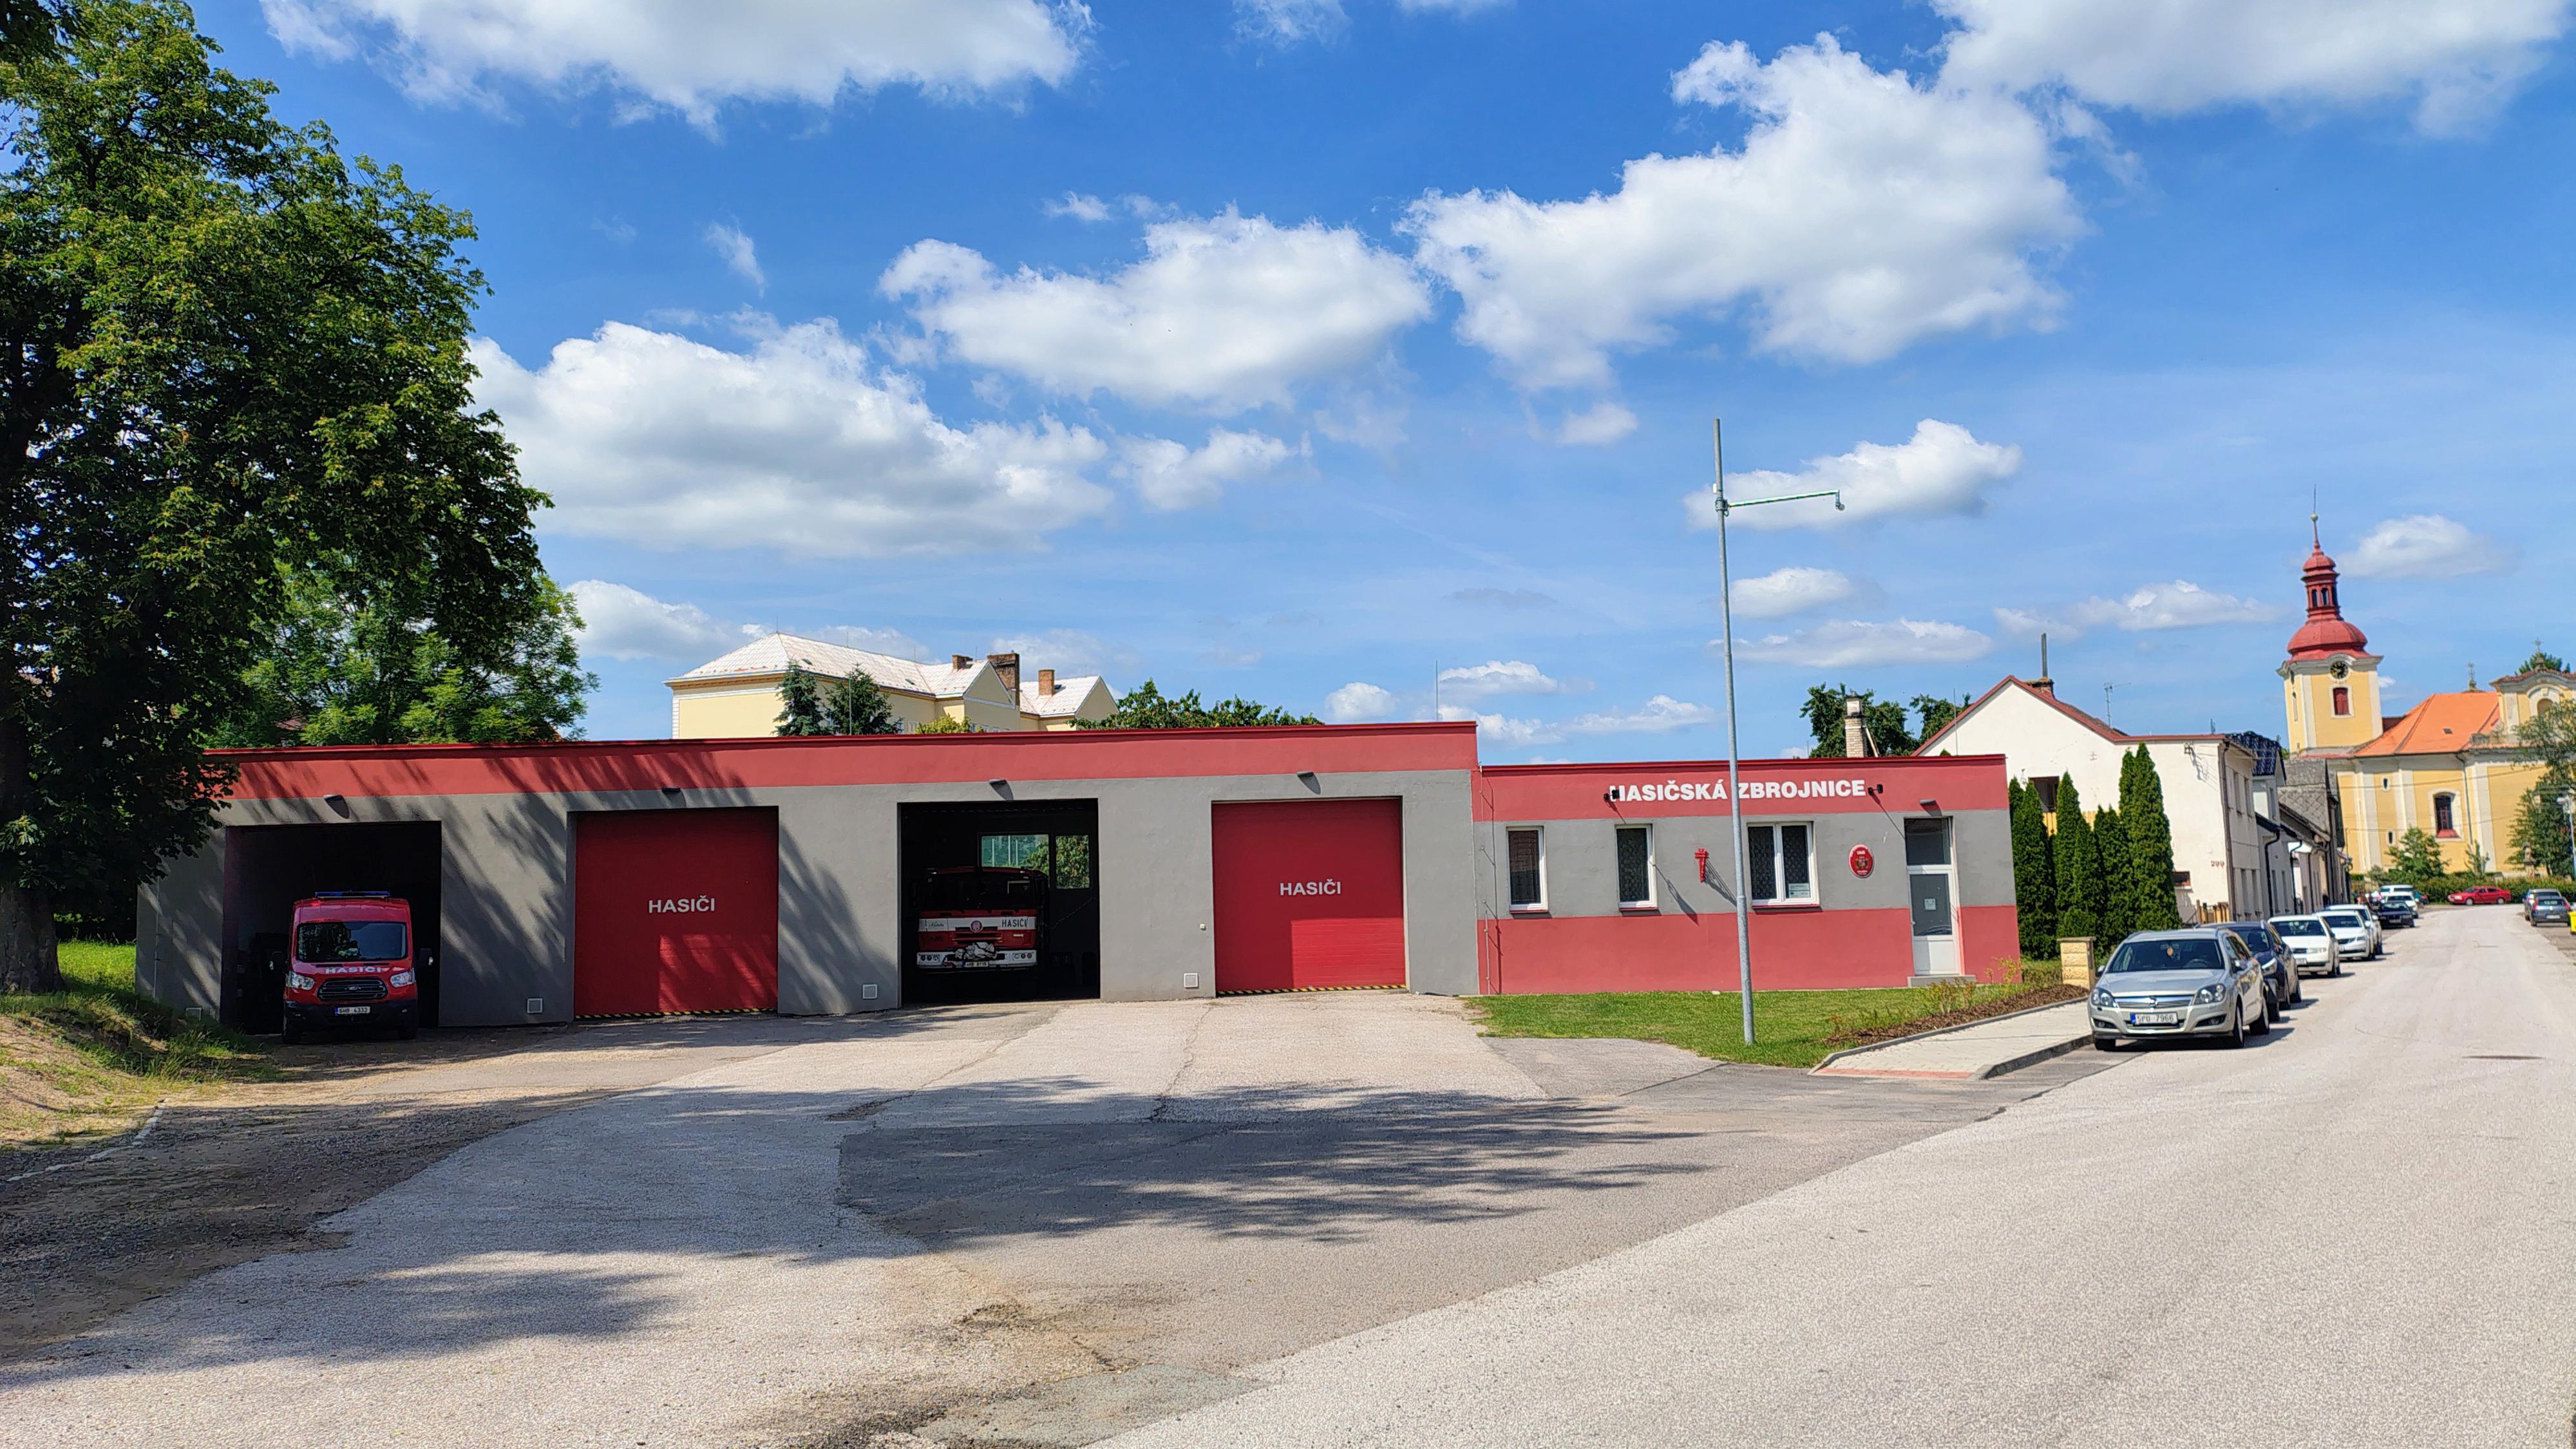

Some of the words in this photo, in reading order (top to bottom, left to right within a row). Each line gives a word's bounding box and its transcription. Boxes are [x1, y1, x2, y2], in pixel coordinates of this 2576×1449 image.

[1738, 780, 1866, 799] ZBROJNICE
[1280, 878, 1341, 896] HASIČI
[649, 895, 715, 913] HASIČI
[1002, 918, 1027, 927] HASIČI
